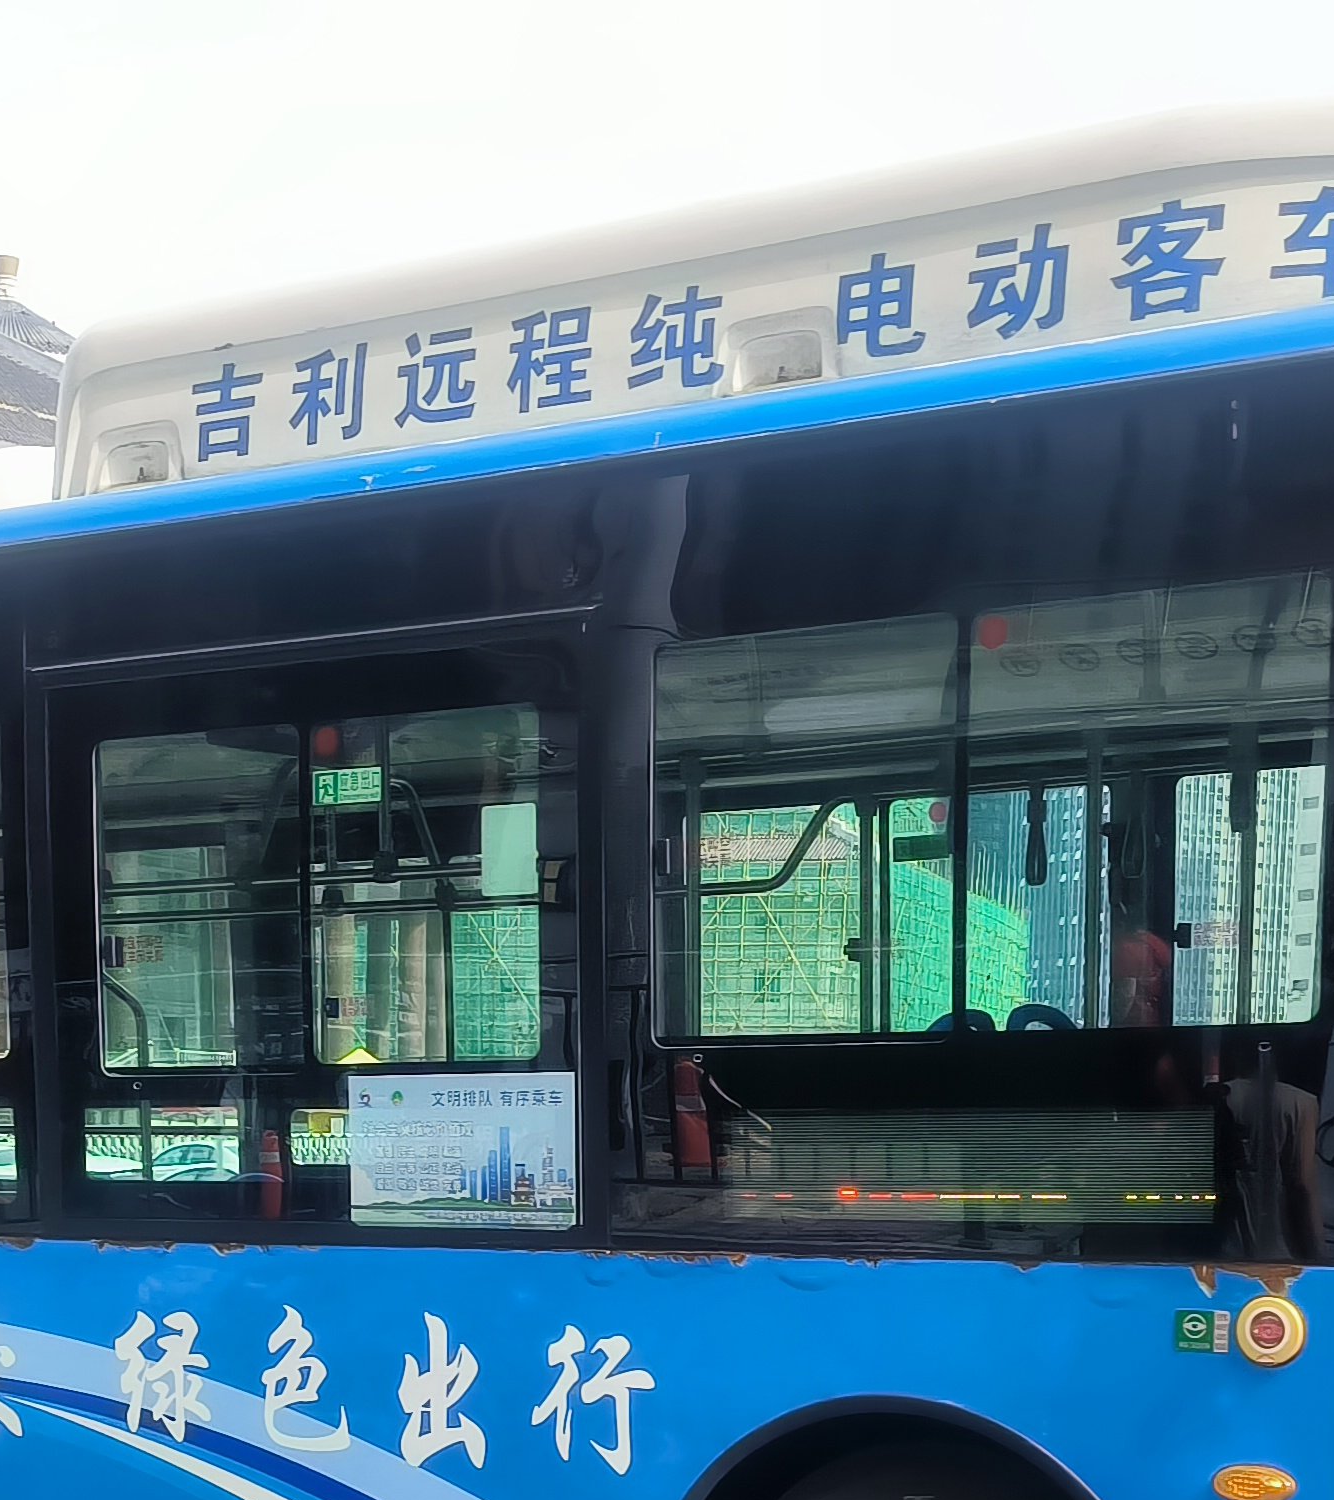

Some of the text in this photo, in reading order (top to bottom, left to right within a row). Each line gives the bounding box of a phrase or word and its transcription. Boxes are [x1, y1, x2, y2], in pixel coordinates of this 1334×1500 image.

[192, 286, 724, 462] 吉利远程纯
[431, 1090, 493, 1107] 文明排队
[117, 1303, 656, 1477] 绿色出行
